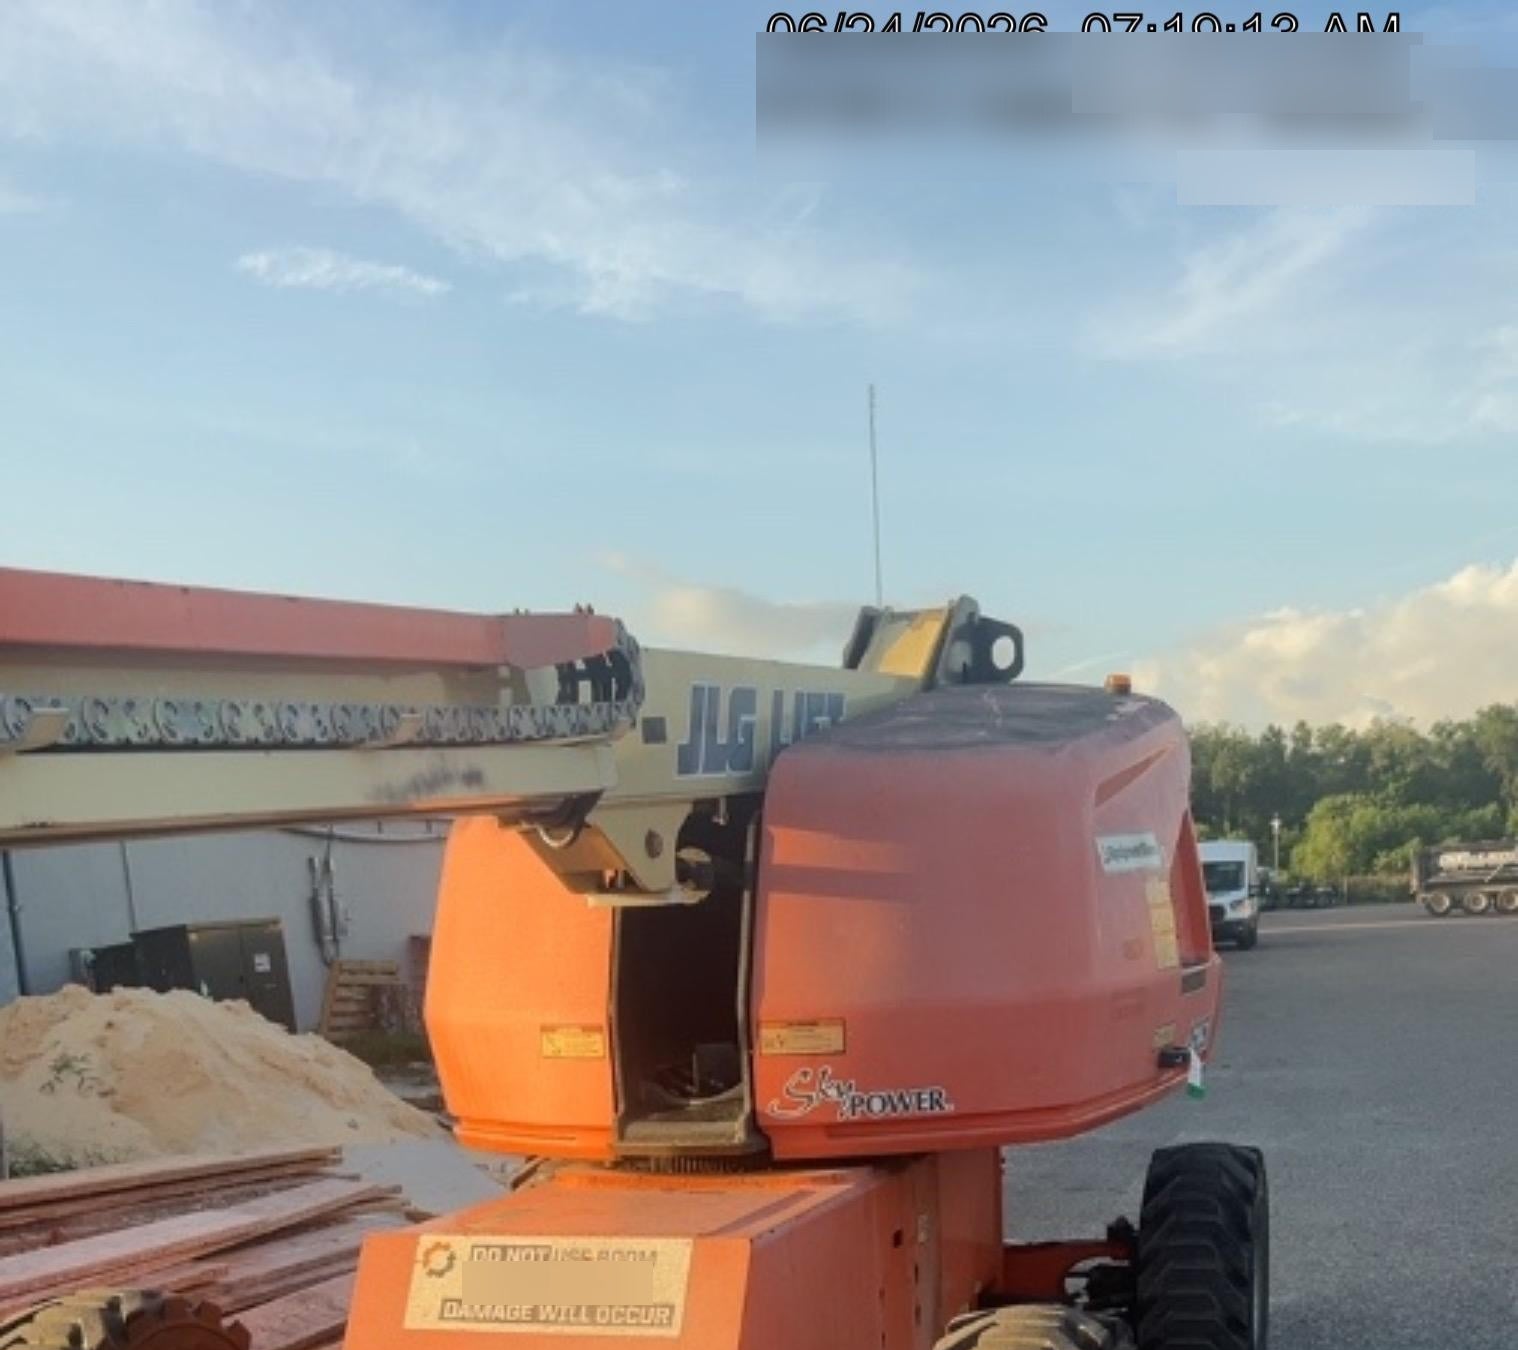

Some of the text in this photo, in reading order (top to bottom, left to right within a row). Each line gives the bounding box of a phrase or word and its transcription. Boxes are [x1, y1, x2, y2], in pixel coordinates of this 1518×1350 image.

[676, 683, 758, 778] JLG
[850, 1086, 946, 1117] POWER
[475, 1248, 501, 1261] DO
[506, 1248, 550, 1261] NOT
[443, 1301, 670, 1325] DAMAGE WILL OCCUR
